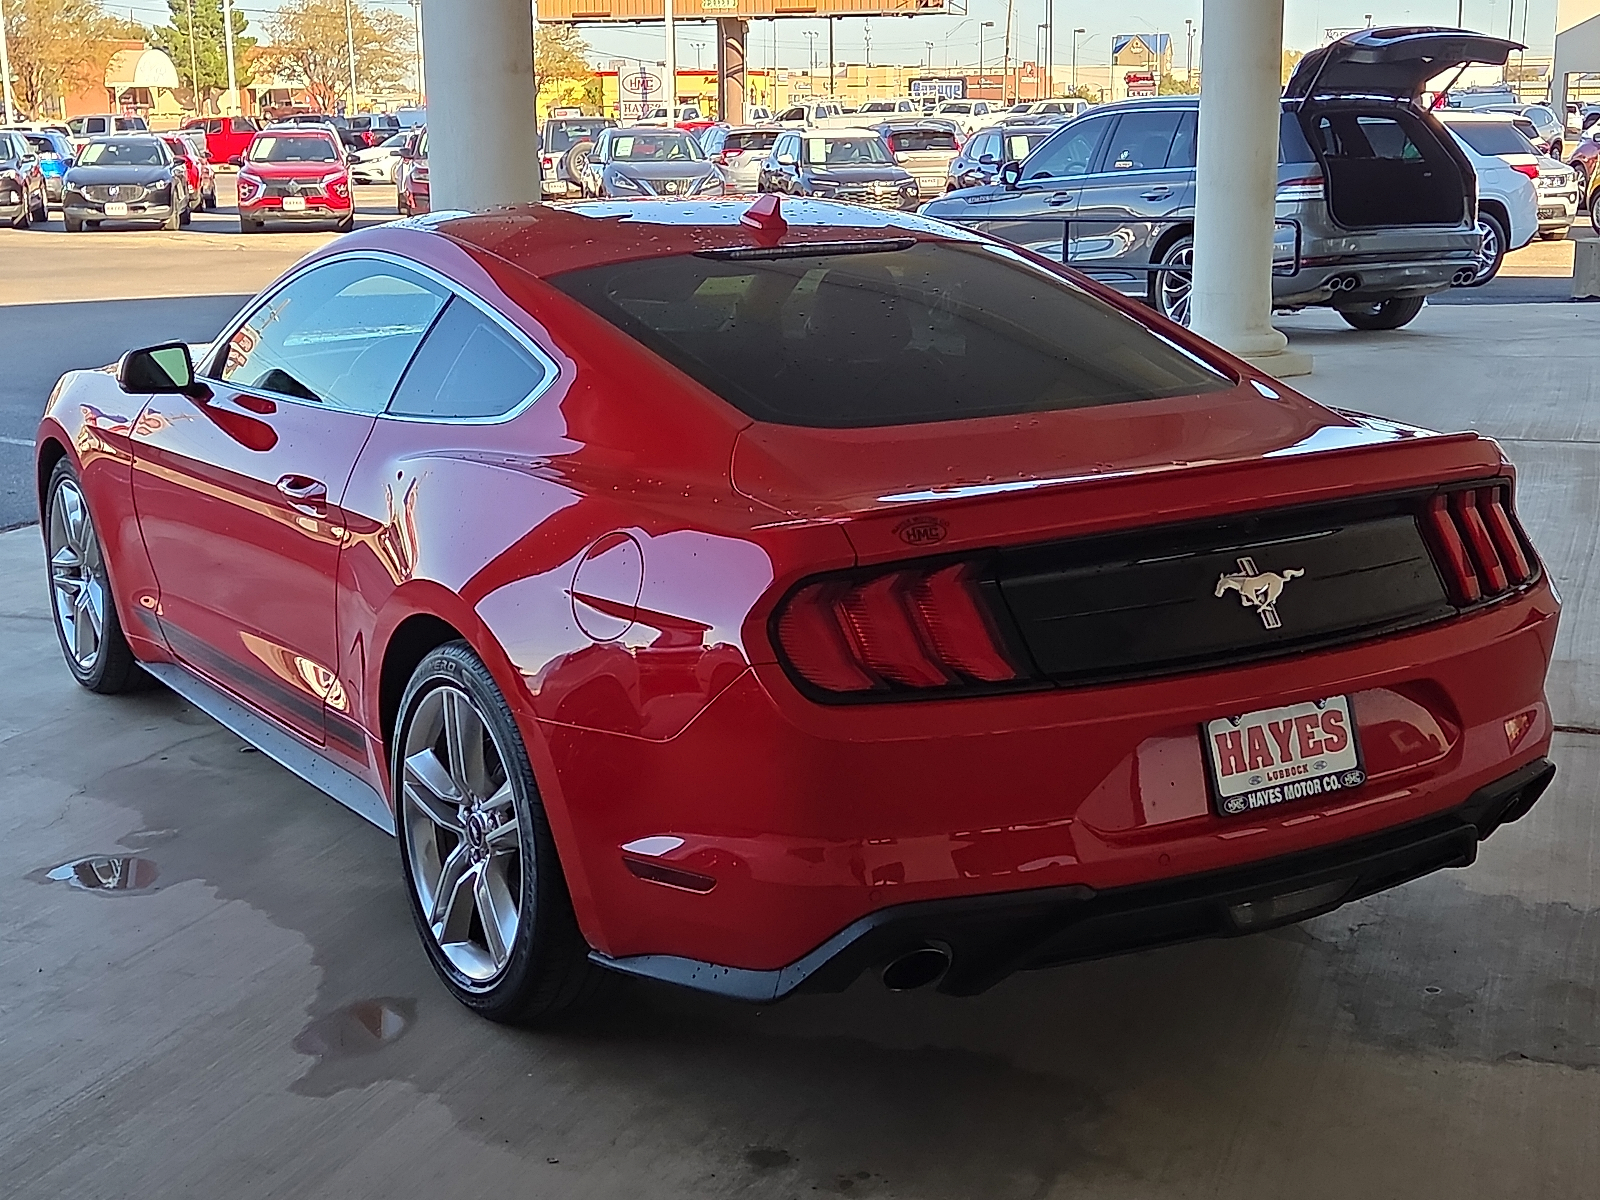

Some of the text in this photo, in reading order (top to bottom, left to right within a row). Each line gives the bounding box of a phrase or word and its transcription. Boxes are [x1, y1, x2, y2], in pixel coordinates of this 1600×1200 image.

[906, 525, 939, 542] HMC
[1214, 709, 1348, 777] HAYES
[1266, 763, 1309, 782] LUBBOCK
[1248, 788, 1283, 809] HAYES
[1284, 777, 1322, 801] MOTOR
[1323, 775, 1342, 791] CO.
